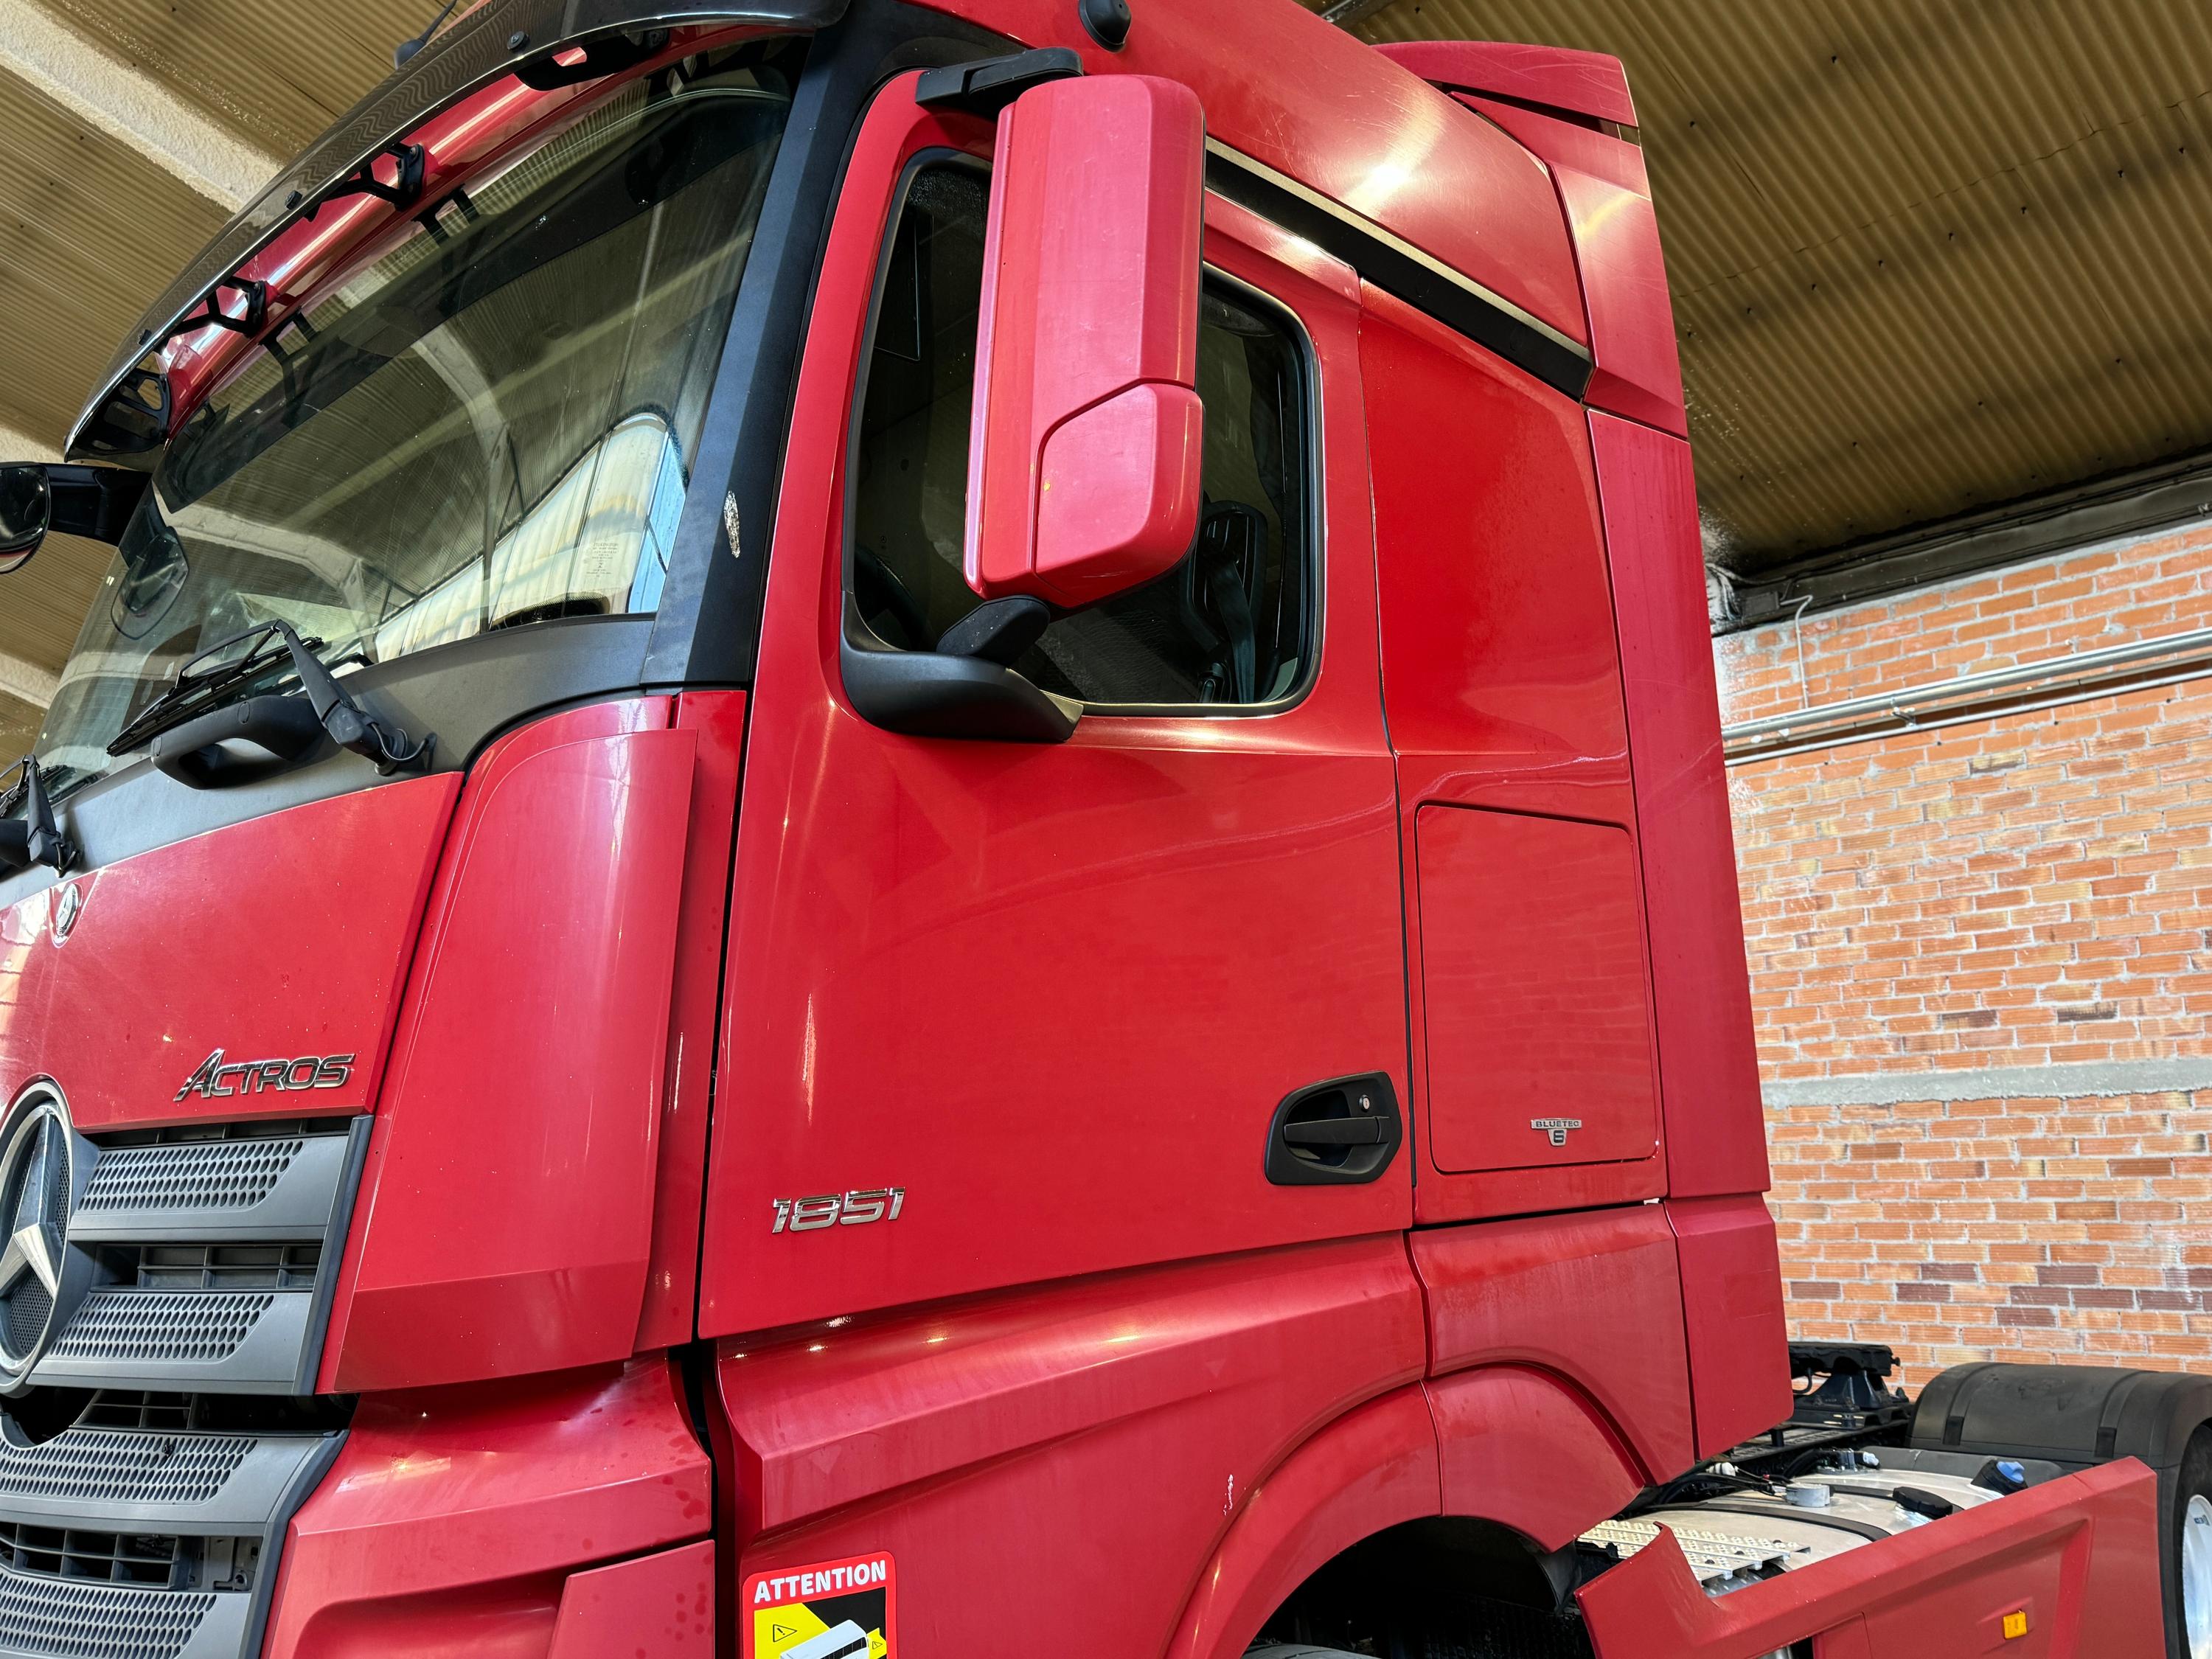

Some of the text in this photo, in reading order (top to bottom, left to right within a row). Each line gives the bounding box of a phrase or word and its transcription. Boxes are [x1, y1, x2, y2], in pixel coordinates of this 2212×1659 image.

[173, 1048, 355, 1102] ACTROS
[1553, 1130, 1565, 1144] 6
[772, 1186, 905, 1234] 1851
[754, 1559, 886, 1604] ATTENTION
